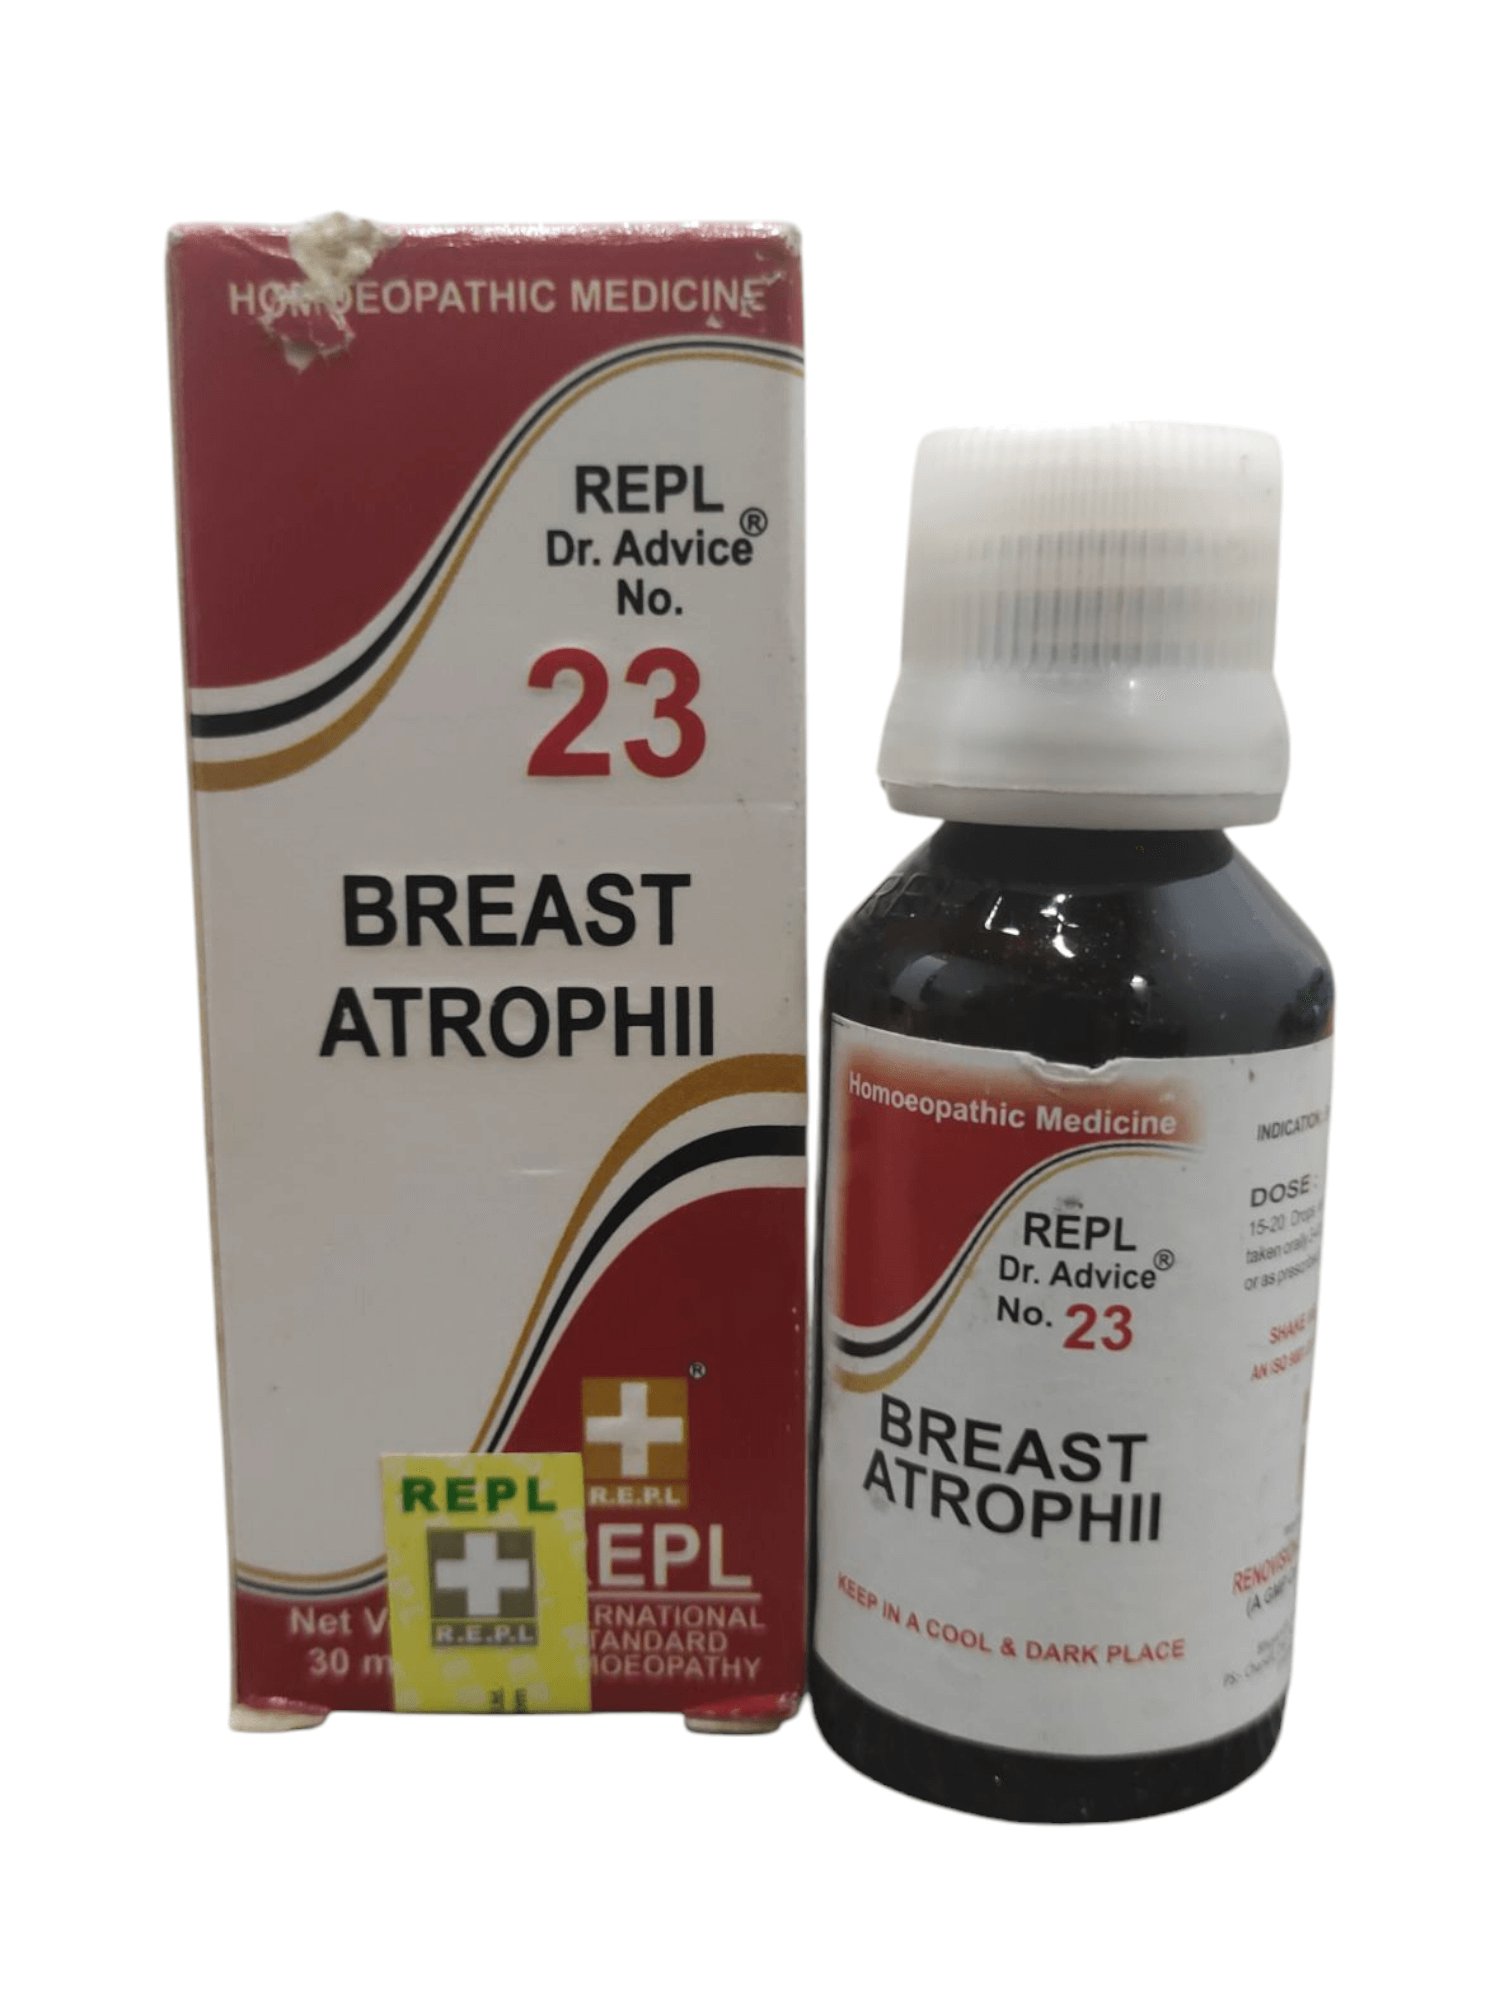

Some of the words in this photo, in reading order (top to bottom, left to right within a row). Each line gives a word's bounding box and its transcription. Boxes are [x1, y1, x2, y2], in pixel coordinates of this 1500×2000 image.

[571, 279, 767, 314] MEDICINE
[575, 465, 725, 513] REPL
[547, 530, 600, 567] Dr.
[617, 579, 682, 615] No.
[527, 646, 706, 779] 23
[343, 873, 691, 946] BREAST
[319, 985, 713, 1058] ATROPHII
[848, 1070, 1026, 1128] Homoeopathic
[1036, 1105, 1177, 1136] Medicine
[1023, 1211, 1137, 1252] REPL
[1249, 1213, 1285, 1237] 15-20
[999, 1255, 1040, 1285] Dr.
[1246, 1242, 1281, 1265] taken
[1244, 1272, 1260, 1292] or
[997, 1295, 1053, 1328] No.
[1063, 1303, 1134, 1352] 23
[880, 1393, 1148, 1484] BREAST
[400, 1475, 558, 1513] REPL
[863, 1448, 1161, 1543] ATROPHII
[591, 1523, 753, 1588] EPL
[290, 1605, 353, 1636] Net
[435, 1623, 535, 1644] R.E.P.L
[593, 1604, 767, 1630] RNATIONAL
[836, 1571, 879, 1611] KEEP
[882, 1601, 900, 1625] IN
[906, 1612, 921, 1634] A
[926, 1618, 991, 1653] COOL
[1000, 1637, 1017, 1659] &
[1026, 1640, 1098, 1664] DARK
[1106, 1638, 1186, 1666] PLACE
[589, 1628, 729, 1654] TANDARD
[309, 1647, 350, 1676] 30
[590, 1654, 761, 1681] OEOPATHY
